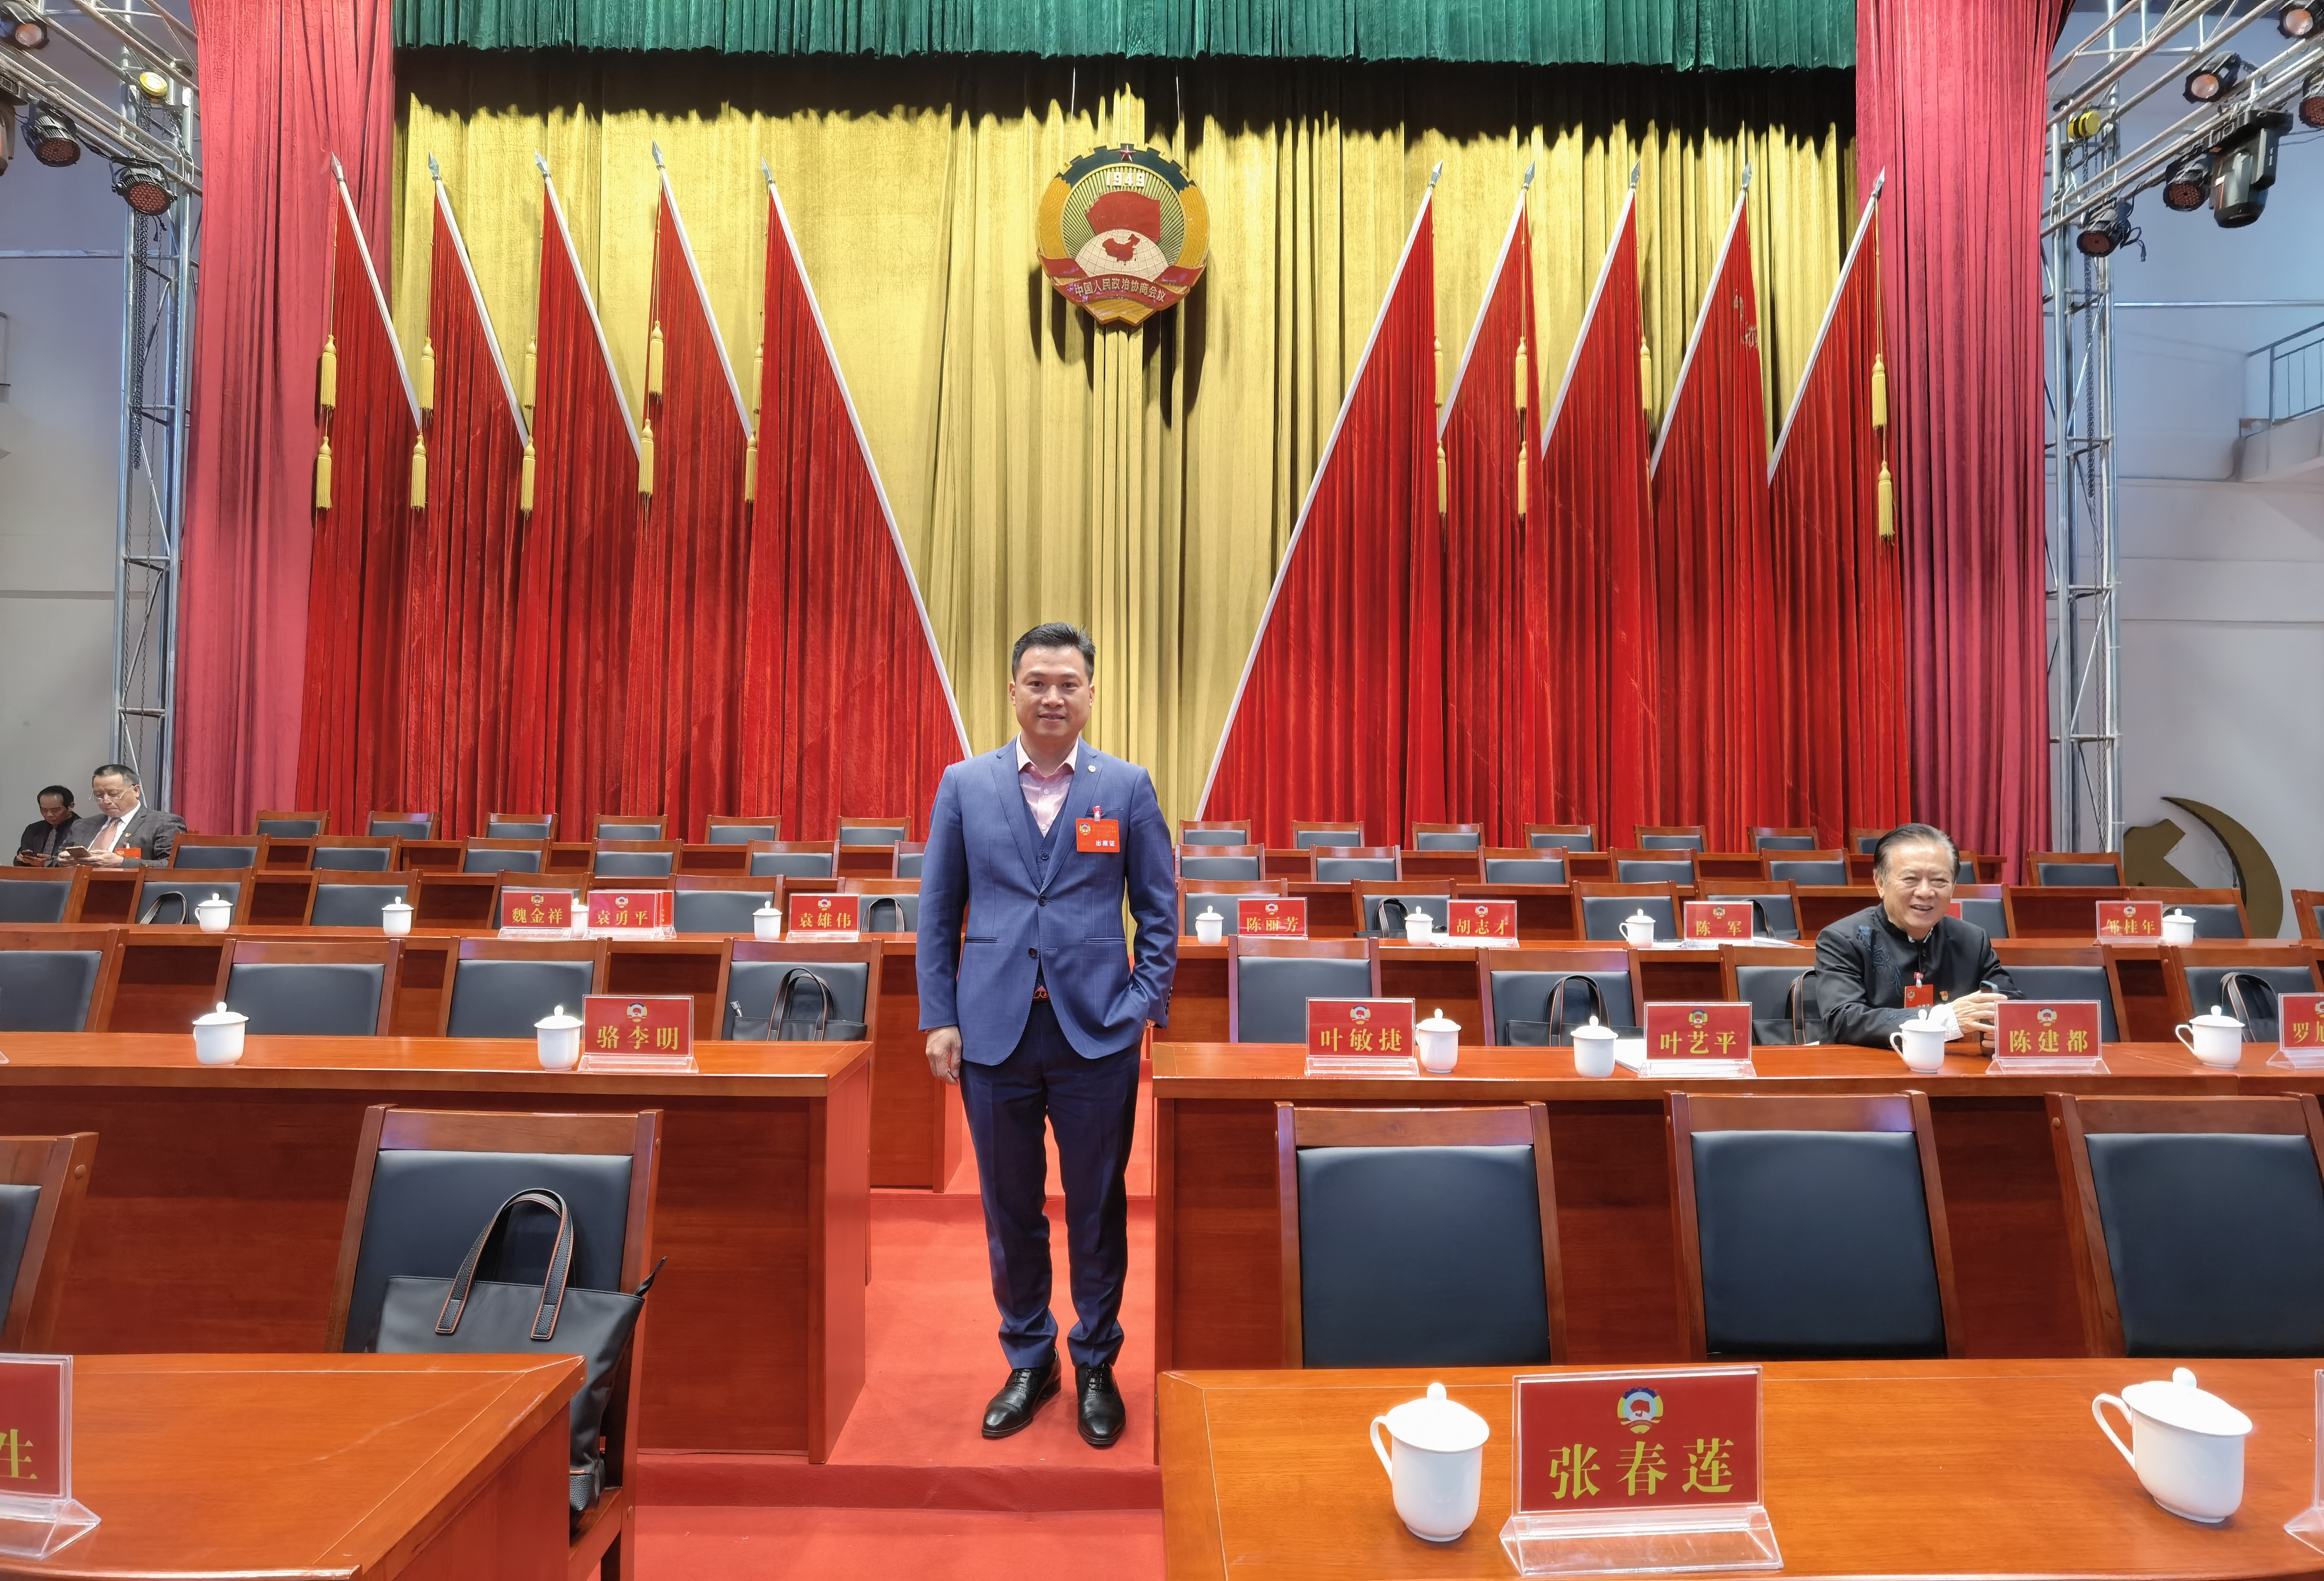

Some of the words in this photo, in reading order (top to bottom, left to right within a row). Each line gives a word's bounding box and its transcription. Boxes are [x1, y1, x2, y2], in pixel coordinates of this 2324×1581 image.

[1106, 172, 1145, 186] 1949
[1075, 278, 1166, 302] 中国人民政治协商会议
[512, 908, 562, 924] 魏金祥
[596, 910, 648, 925] 袁勇平
[798, 913, 851, 928] 袁雄伟
[1247, 916, 1298, 932] 陈丽芳
[1457, 919, 1508, 935] 胡志才
[597, 1026, 678, 1050] 骆李明
[1321, 1028, 1402, 1051] 叶敏捷
[1660, 1031, 1736, 1054] 叶艺平
[2010, 1029, 2088, 1053] 陈建都
[1549, 1438, 1734, 1499] 张春莲
